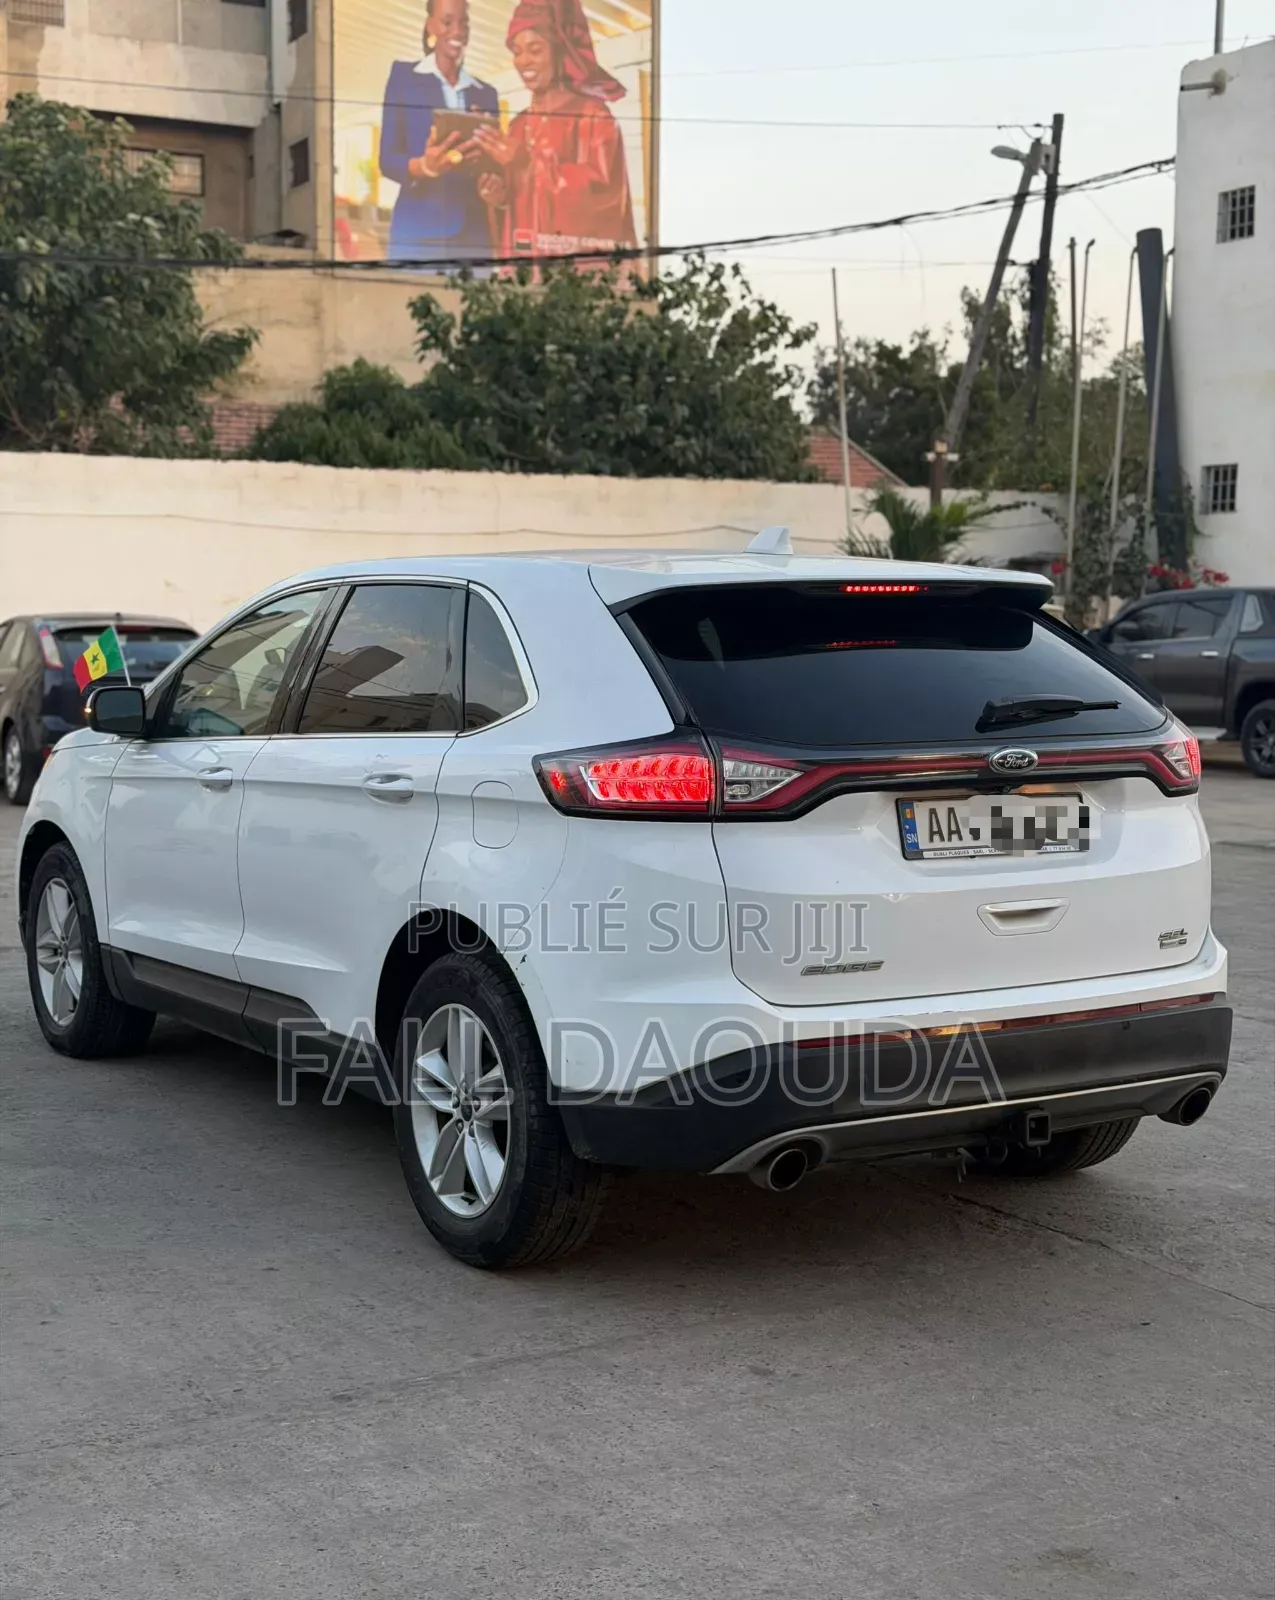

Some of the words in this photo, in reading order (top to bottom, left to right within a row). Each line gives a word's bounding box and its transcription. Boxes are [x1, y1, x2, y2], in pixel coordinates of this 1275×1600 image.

[1004, 753, 1029, 767] Ford
[906, 833, 918, 843] SN
[801, 960, 885, 976] EDGE
